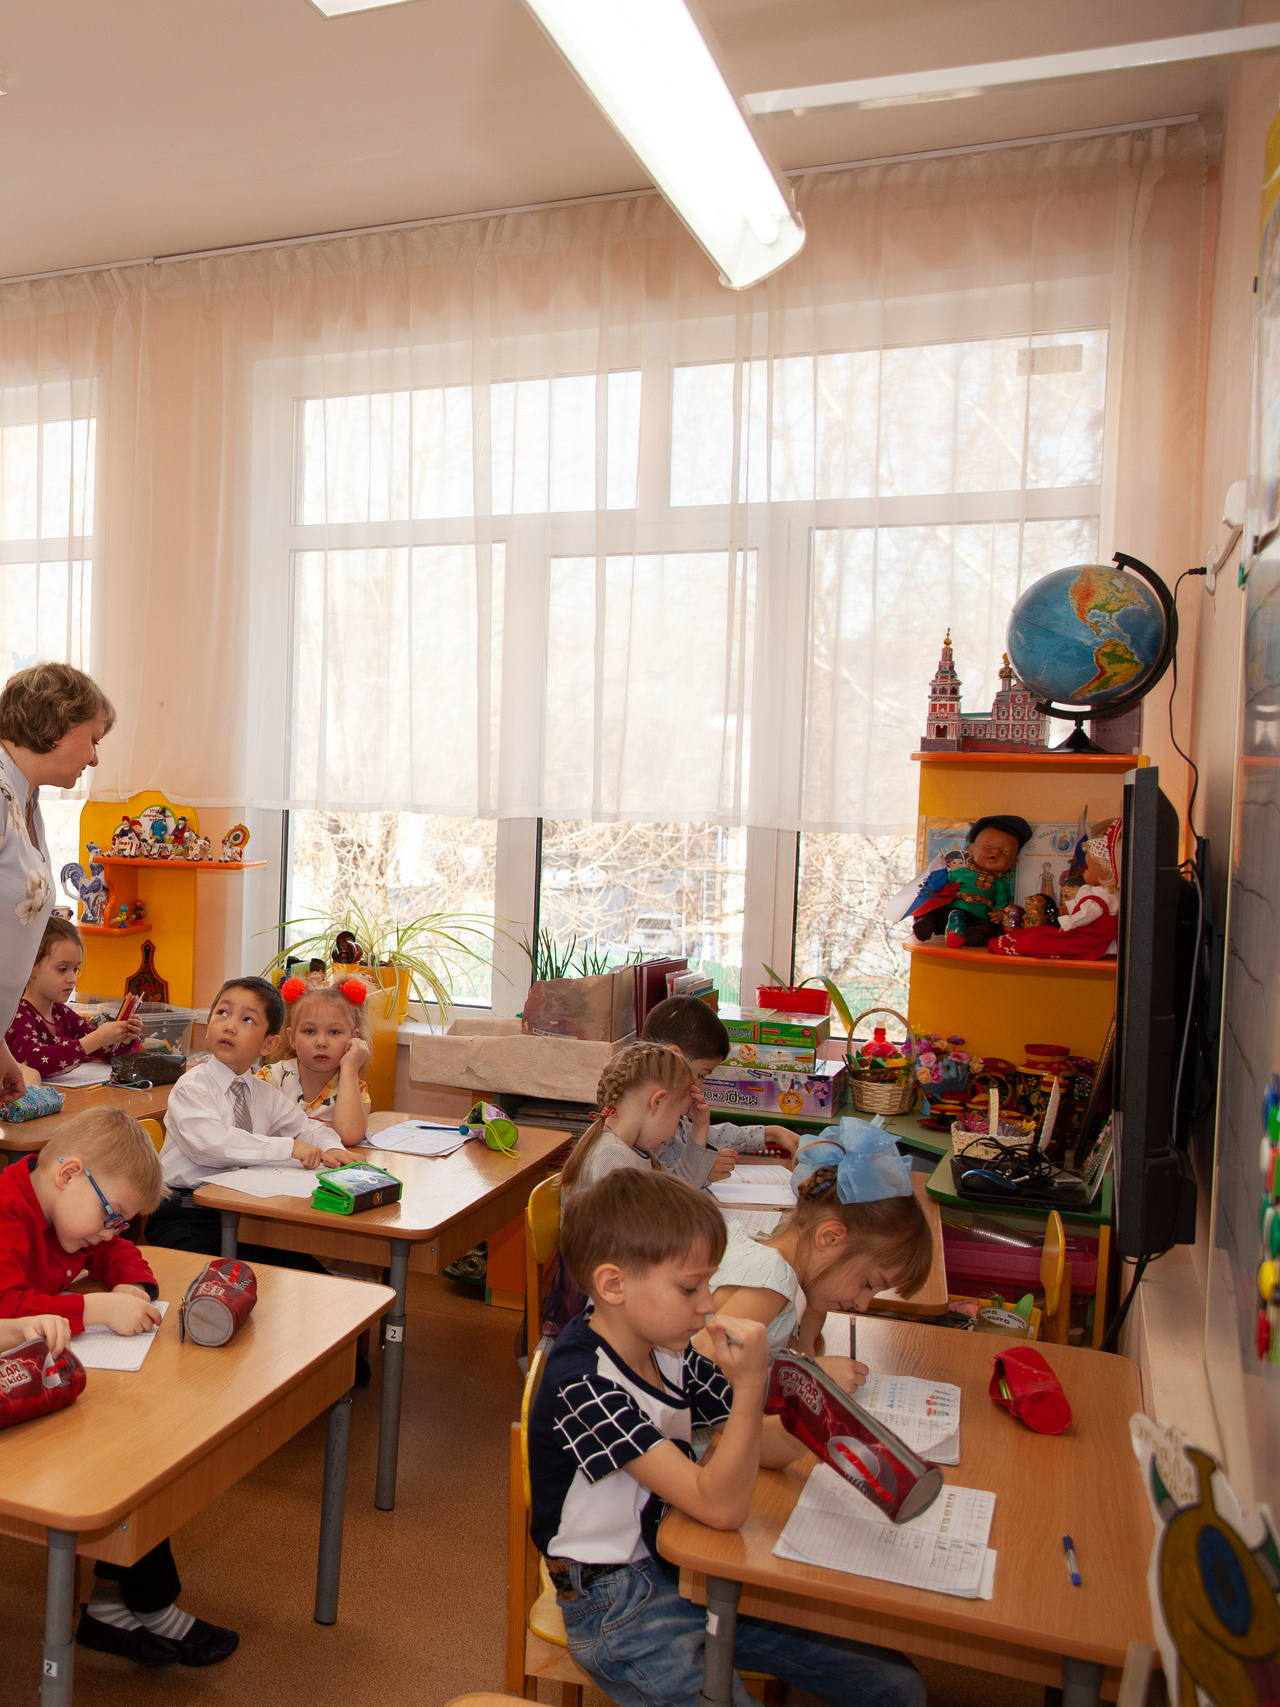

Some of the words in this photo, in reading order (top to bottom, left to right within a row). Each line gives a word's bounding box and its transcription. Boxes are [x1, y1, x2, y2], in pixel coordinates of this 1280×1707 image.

[390, 1329, 397, 1339] 2
[6, 1372, 29, 1385] kids
[782, 1370, 820, 1400] POLAR
[798, 1387, 819, 1412] kids
[46, 1661, 53, 1675] 2
